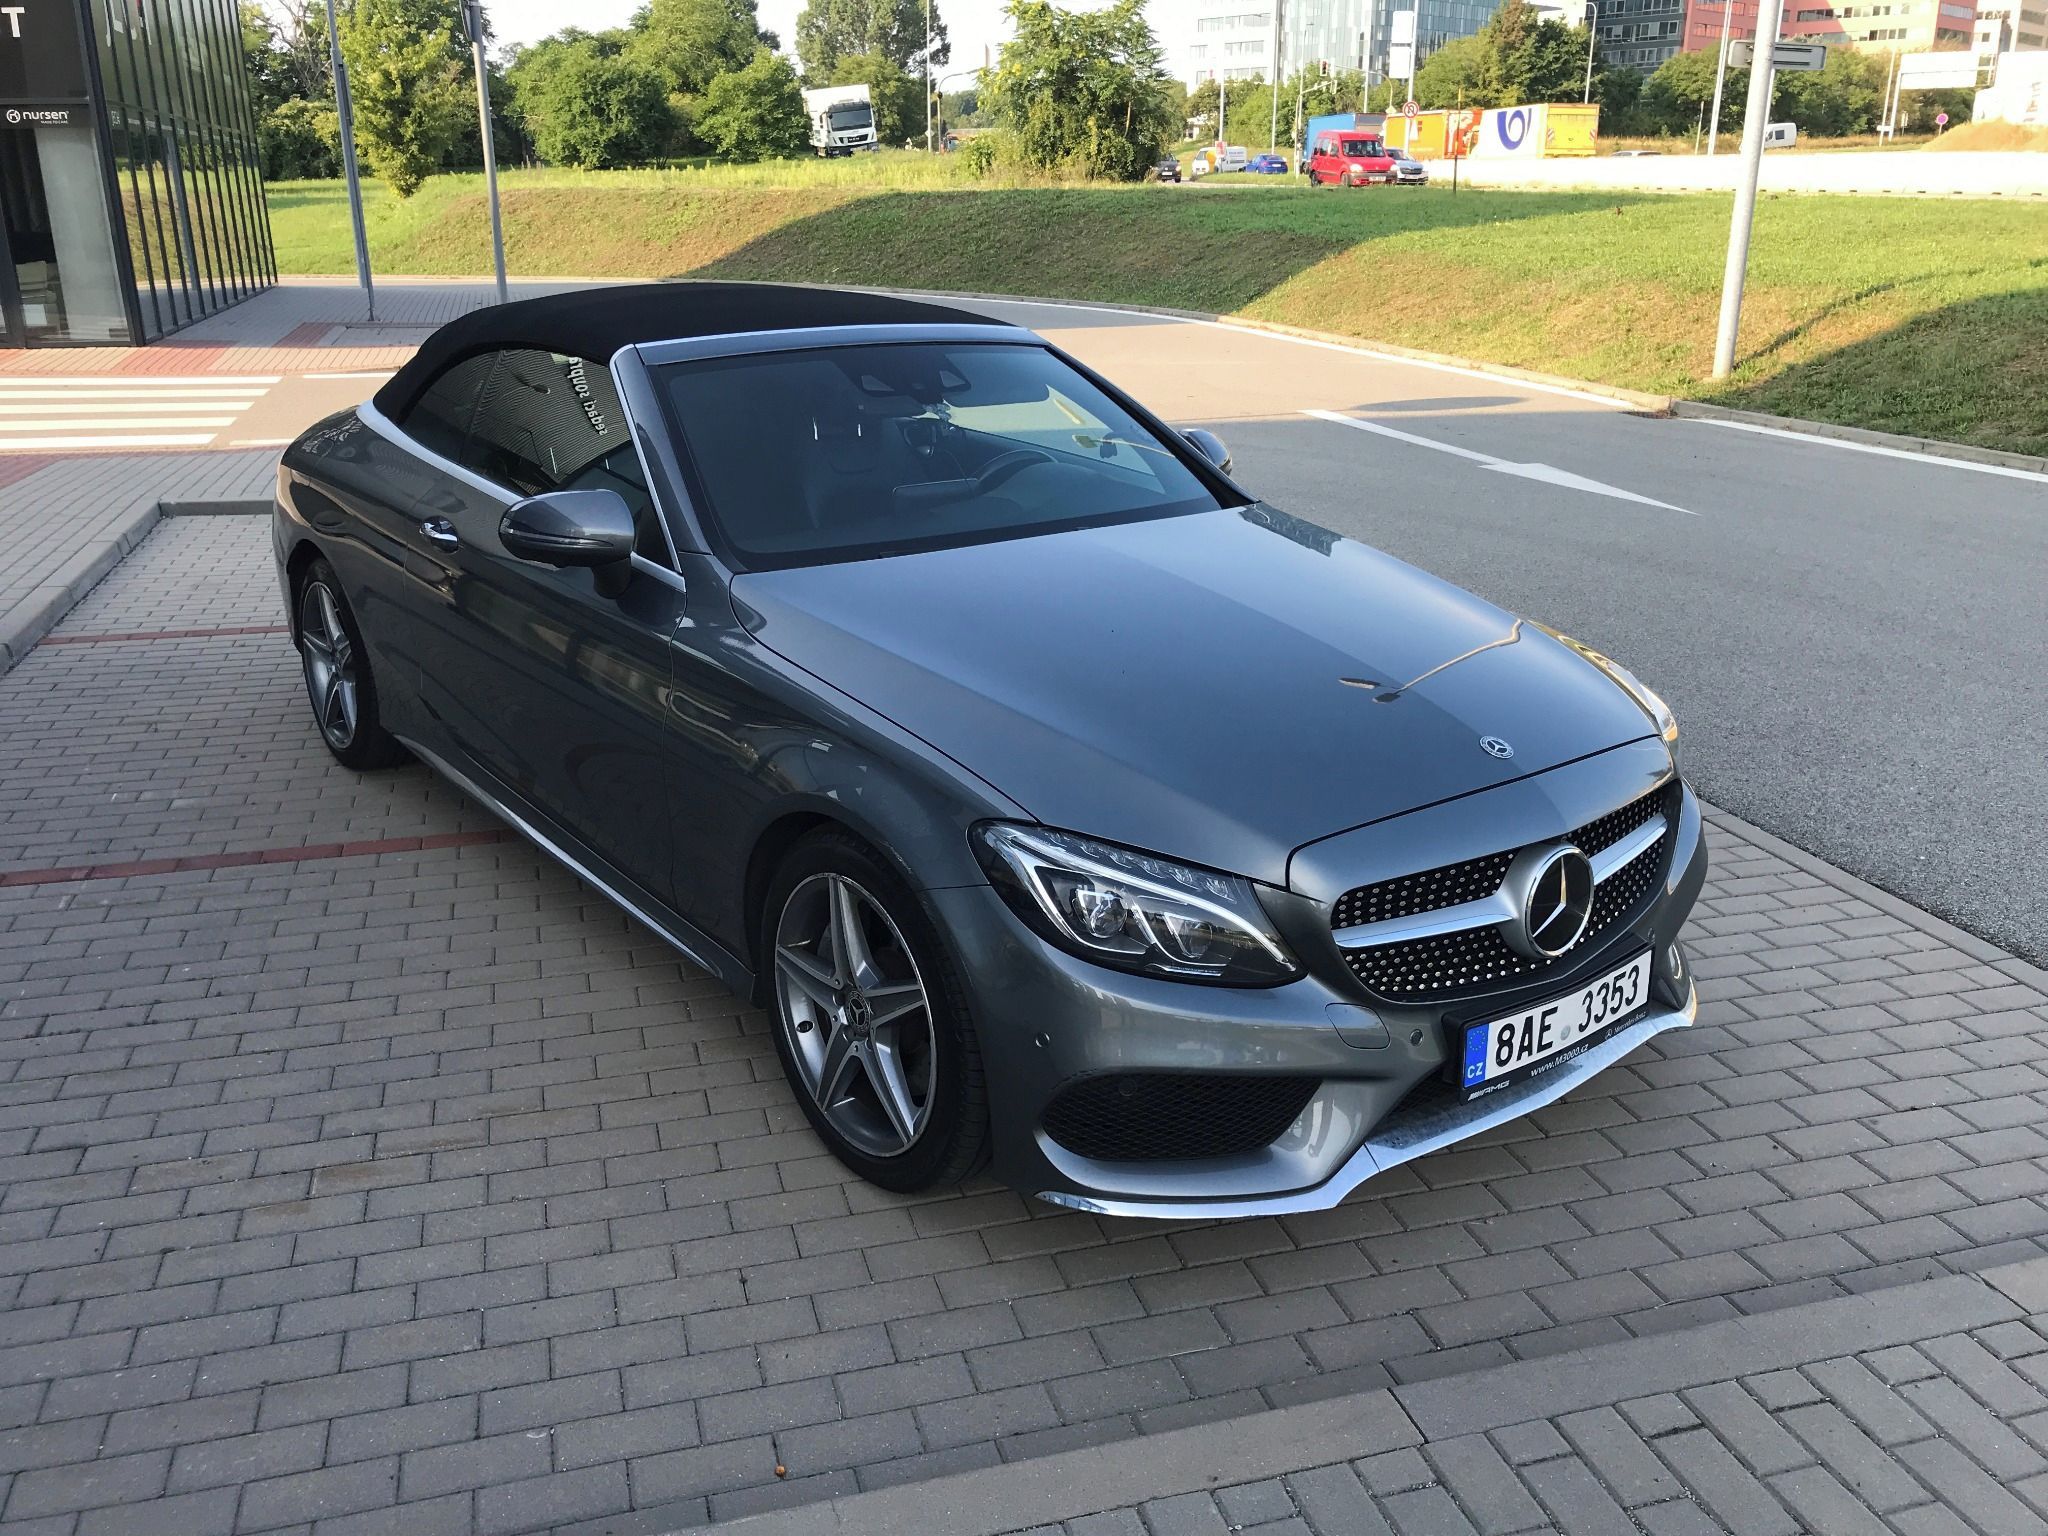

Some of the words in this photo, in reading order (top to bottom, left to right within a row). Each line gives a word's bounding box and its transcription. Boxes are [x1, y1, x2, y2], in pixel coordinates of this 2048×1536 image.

[1, 6, 25, 38] T
[22, 111, 68, 120] nursen
[1495, 1006, 1558, 1067] 8AE
[1578, 964, 1640, 1033] 3353
[1467, 1062, 1483, 1078] CZ
